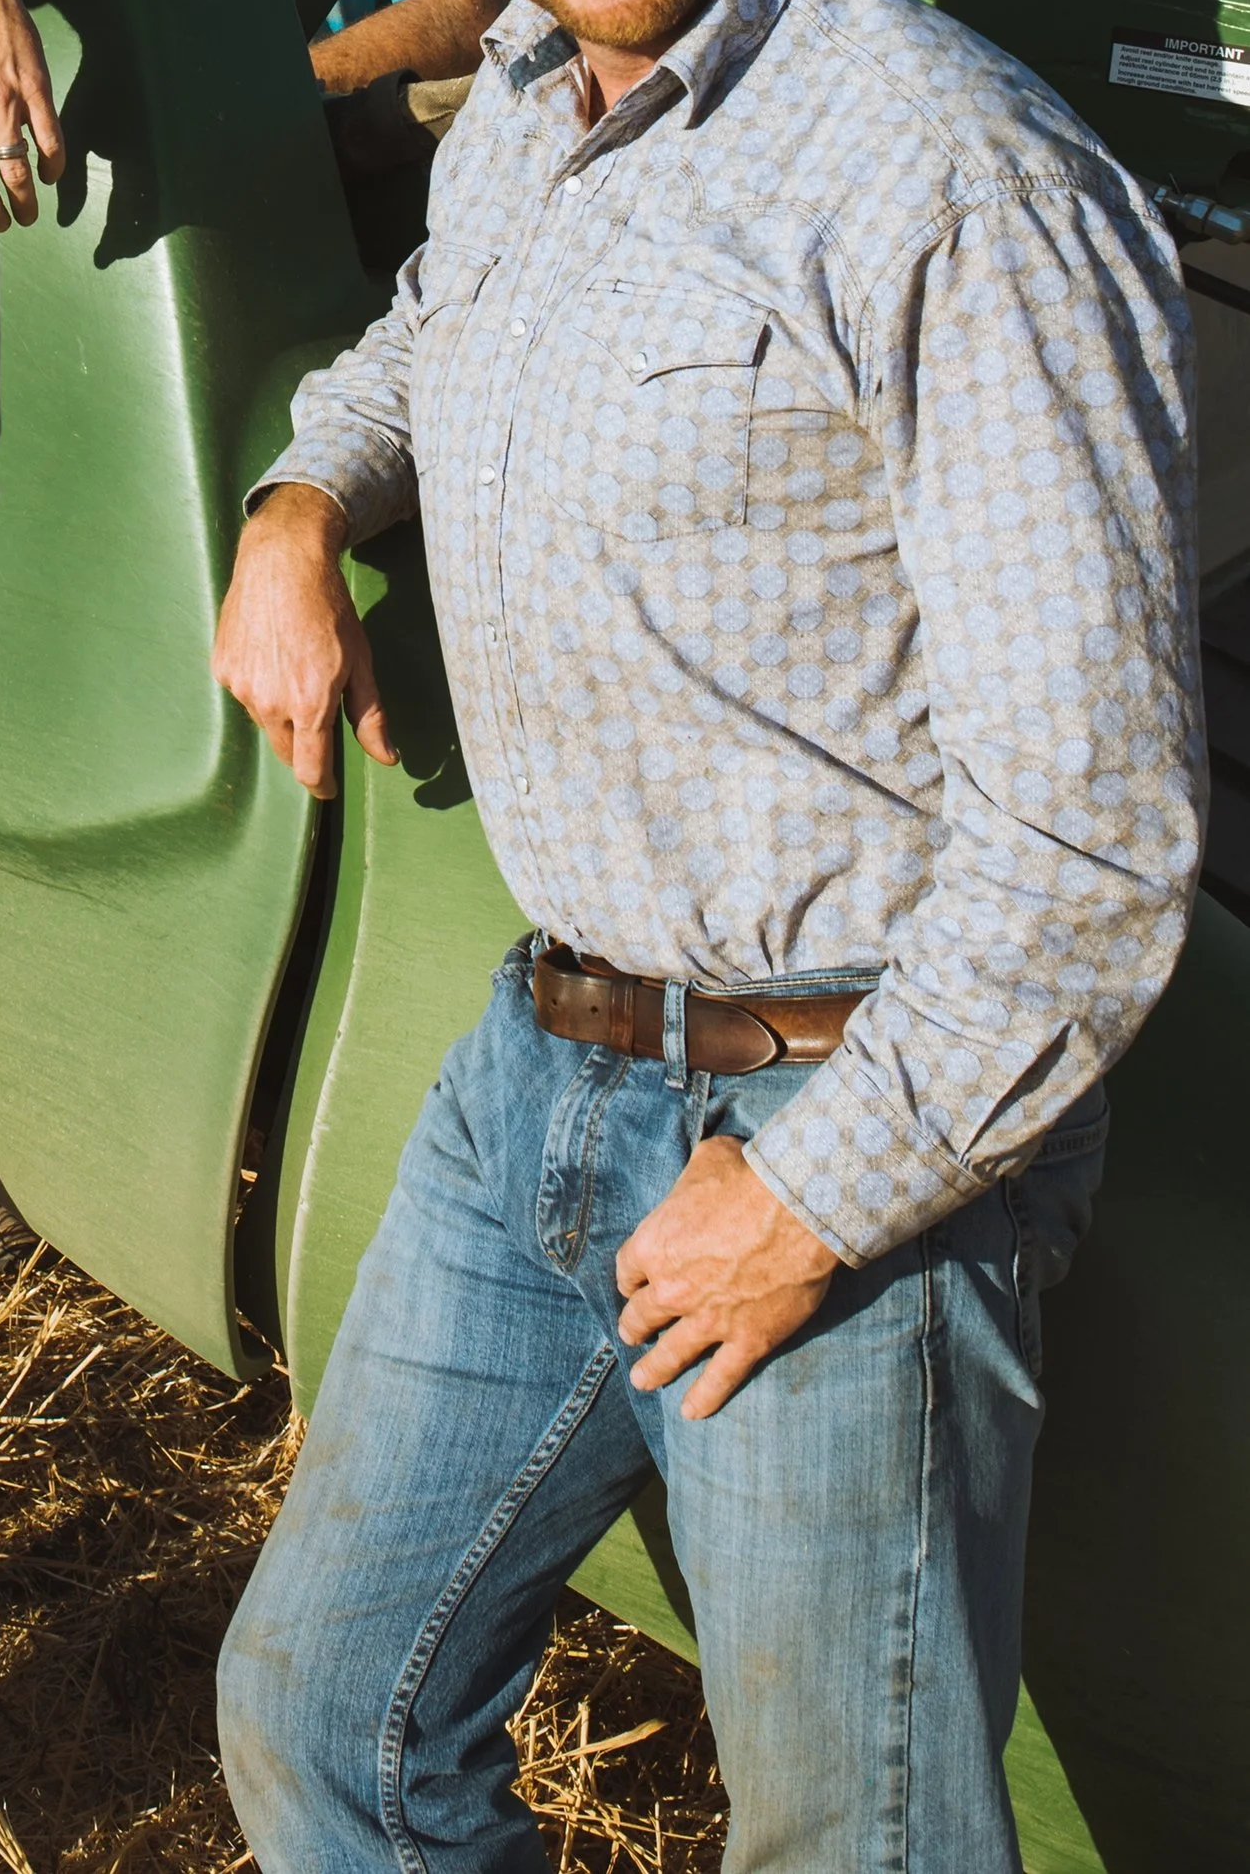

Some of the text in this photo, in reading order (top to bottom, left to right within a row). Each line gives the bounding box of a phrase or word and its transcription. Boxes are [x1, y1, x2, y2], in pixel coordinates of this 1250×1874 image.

[1164, 37, 1245, 61] IMPORTANT
[1119, 61, 1147, 71] reel/knife
[1149, 66, 1180, 76] clearance
[1120, 54, 1140, 64] Adjust
[1142, 57, 1154, 65] reel
[1155, 59, 1181, 69] cylinder
[1118, 69, 1145, 79] Increase
[1146, 74, 1177, 84] clearance
[1178, 78, 1192, 87] with
[1137, 79, 1159, 88] ground
